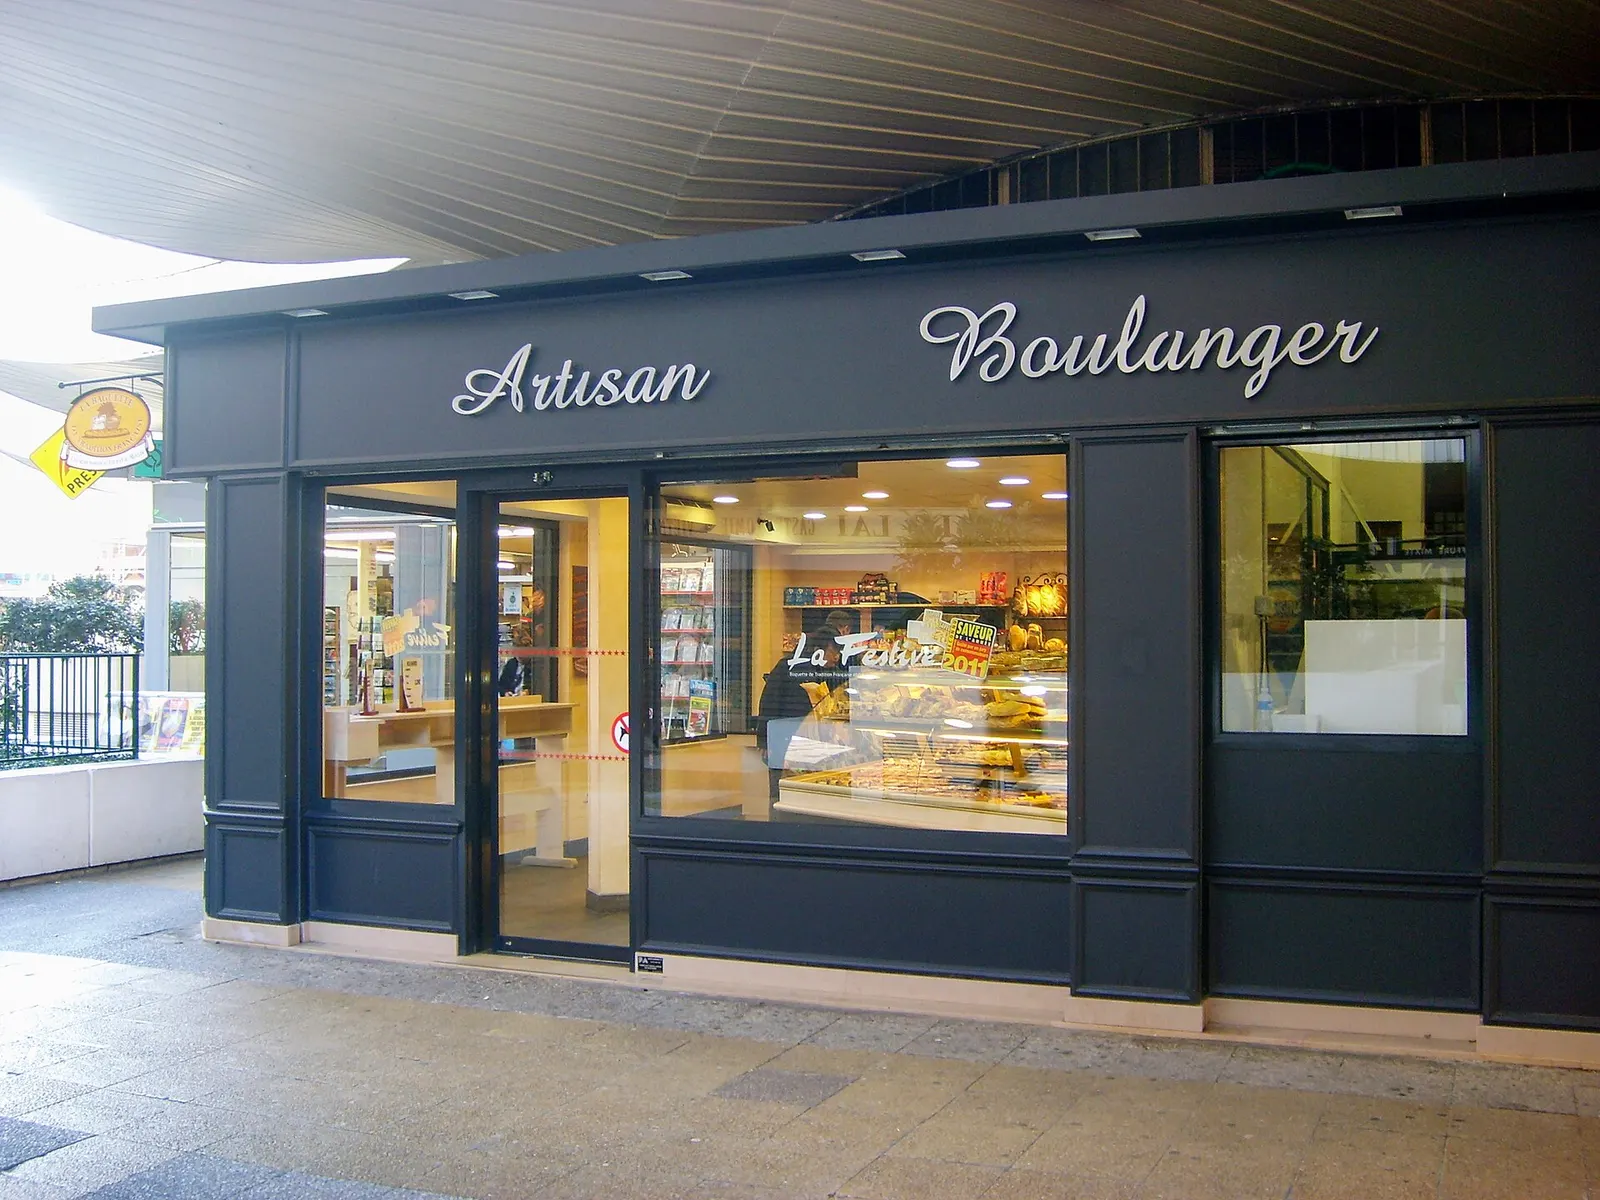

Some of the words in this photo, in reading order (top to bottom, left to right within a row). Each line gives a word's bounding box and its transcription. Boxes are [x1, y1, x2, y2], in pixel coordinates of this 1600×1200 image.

[452, 343, 711, 416] Artisan
[919, 294, 1379, 399] Boulanger
[956, 621, 994, 642] SAVEUR
[787, 632, 828, 671] La
[834, 632, 940, 668] Festive
[943, 653, 988, 678] 2011
